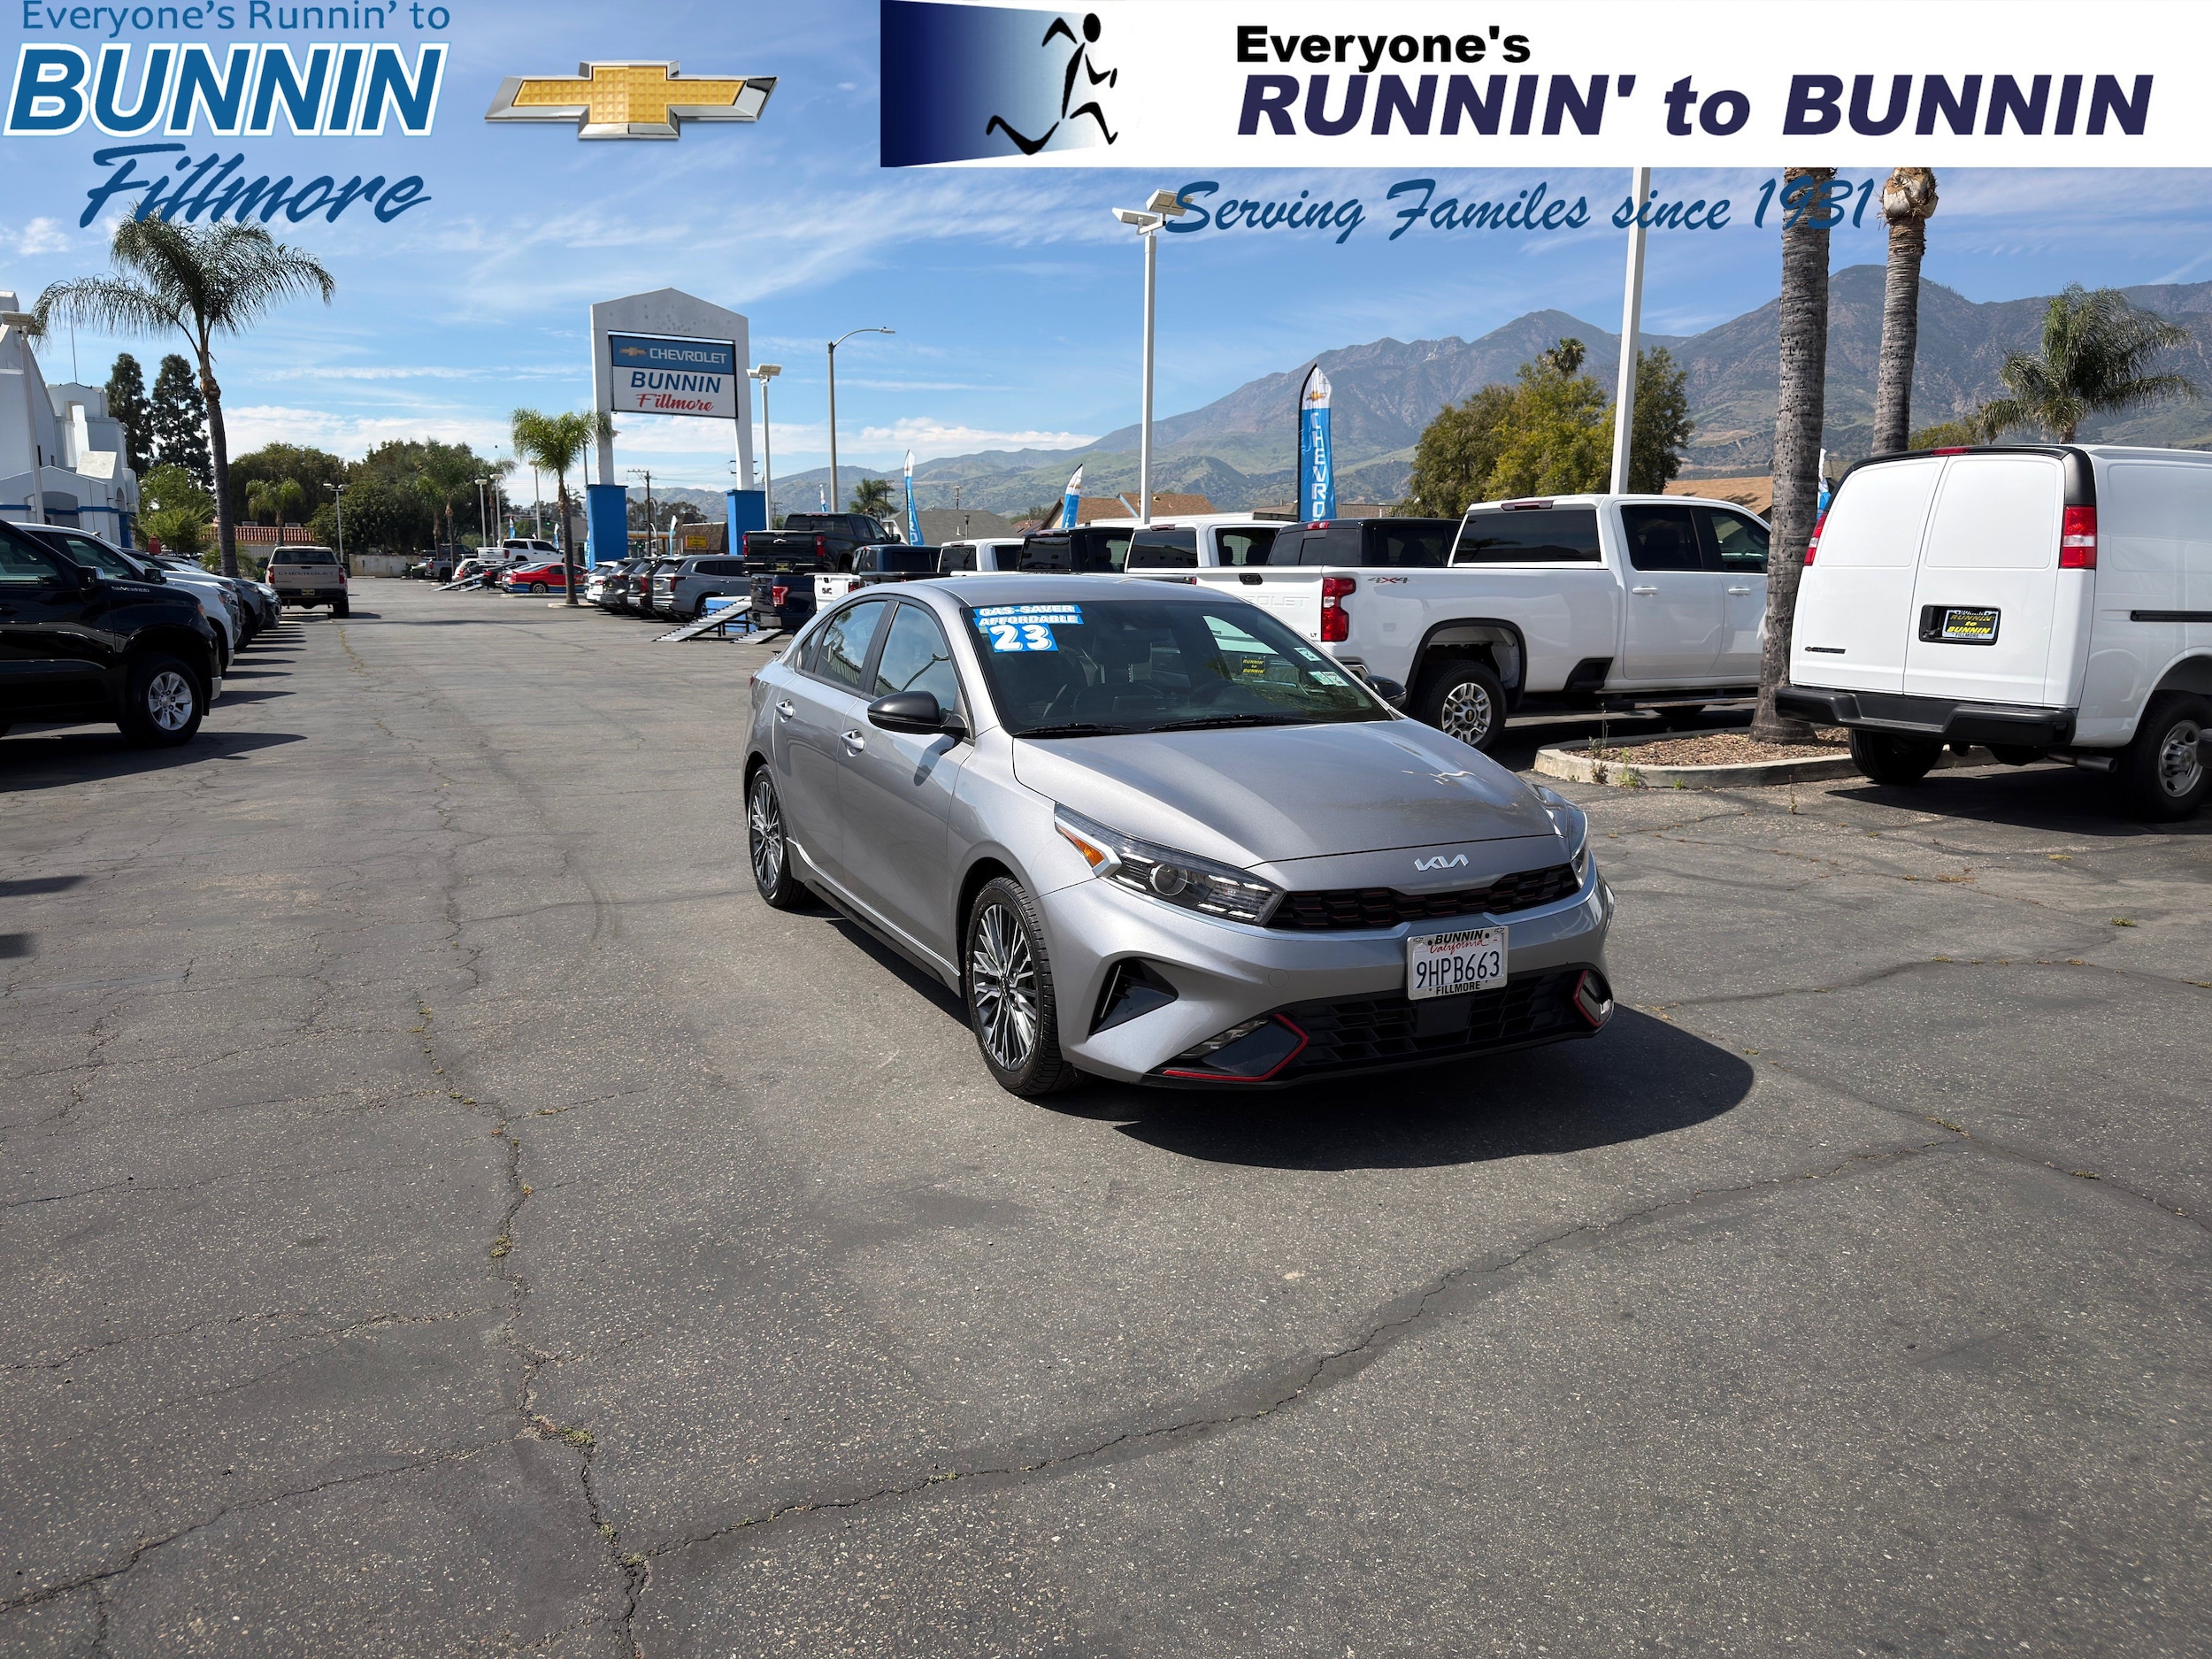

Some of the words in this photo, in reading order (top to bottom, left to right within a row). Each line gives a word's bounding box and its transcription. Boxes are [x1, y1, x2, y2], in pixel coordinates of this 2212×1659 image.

[649, 349, 726, 364] CHEVROLET
[630, 371, 721, 394] BUNNIN
[635, 393, 714, 412] Fillmore
[1310, 412, 1327, 522] CHEVRO
[979, 604, 1076, 617] GAS-SAVER
[979, 615, 1079, 626] AFFORDABLE
[989, 624, 1052, 651] 23
[1414, 854, 1470, 872] KIA
[1434, 929, 1484, 945] BUNNIN
[1430, 939, 1489, 955] California
[1416, 950, 1501, 989] 9HPB663
[1435, 980, 1481, 995] FILLMORE
